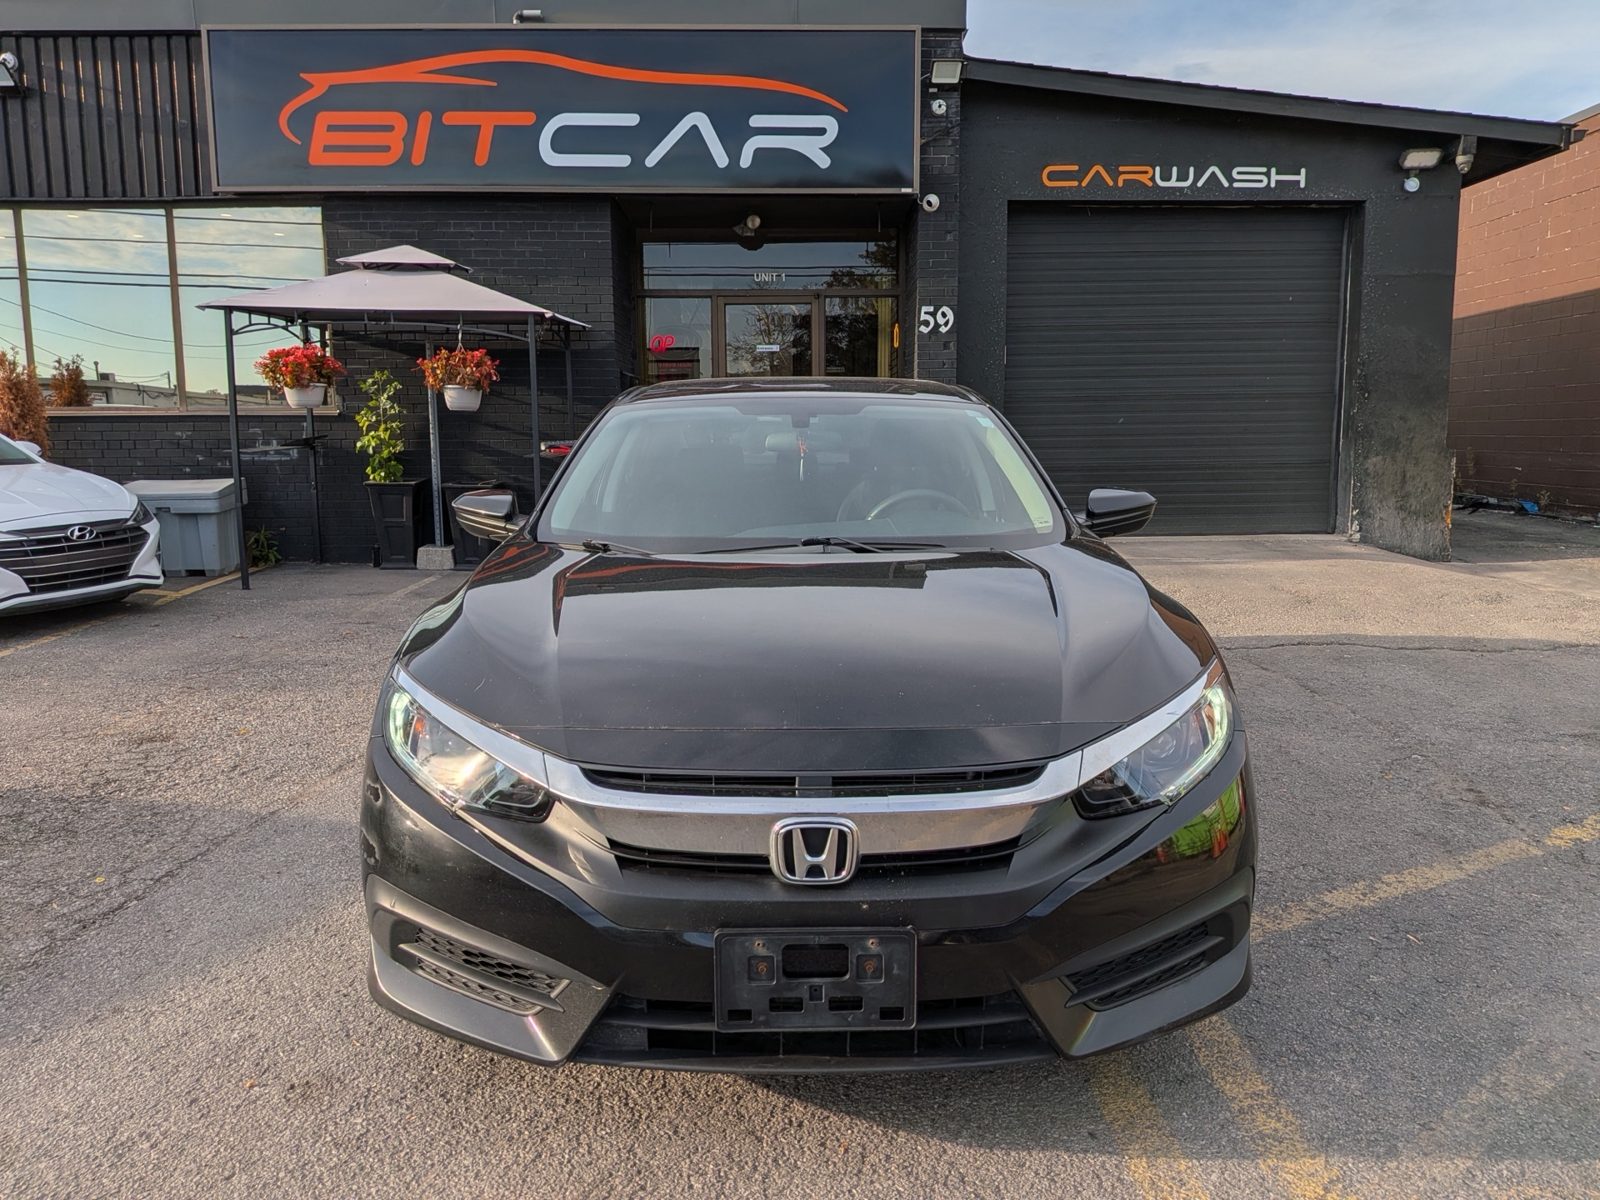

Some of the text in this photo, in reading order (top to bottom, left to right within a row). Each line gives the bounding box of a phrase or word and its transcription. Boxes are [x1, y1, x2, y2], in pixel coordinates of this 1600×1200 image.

[308, 110, 839, 169] BITCAR
[1041, 164, 1306, 188] CARWASH
[754, 272, 786, 282] UNIT 1
[918, 305, 954, 333] 59
